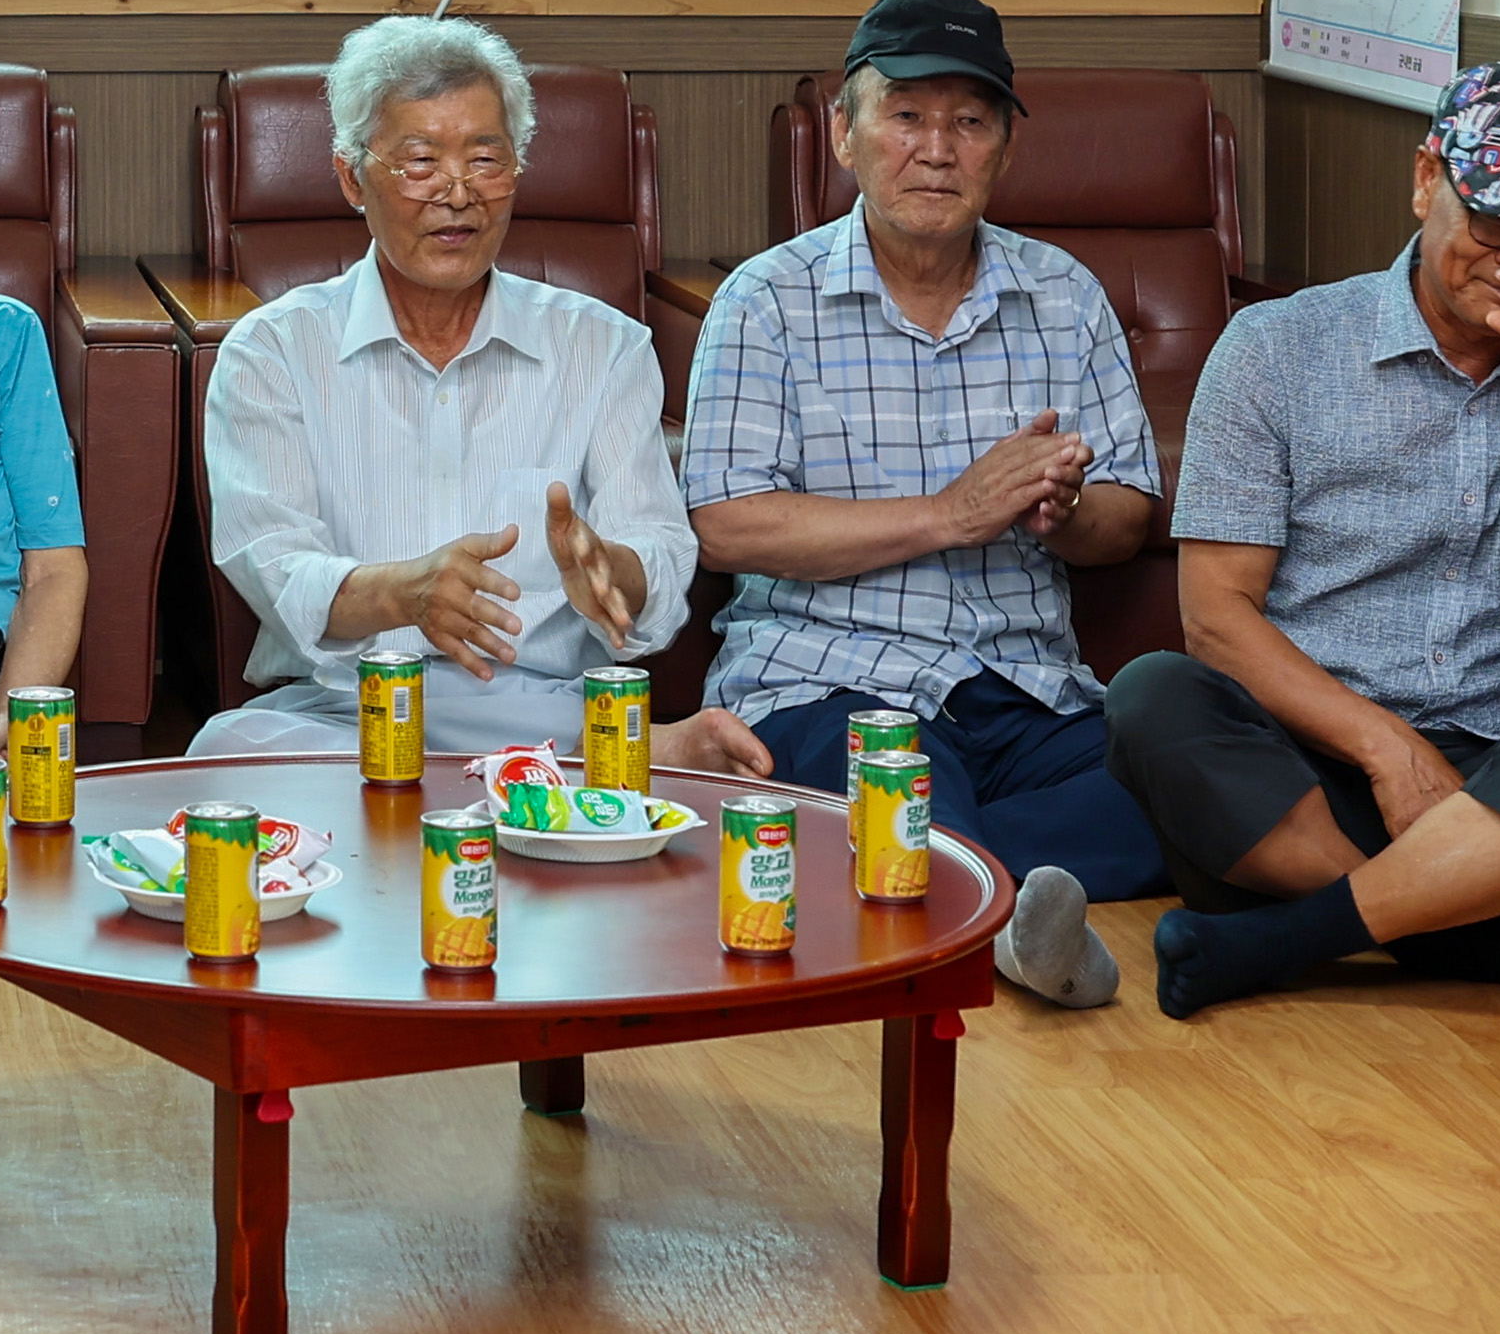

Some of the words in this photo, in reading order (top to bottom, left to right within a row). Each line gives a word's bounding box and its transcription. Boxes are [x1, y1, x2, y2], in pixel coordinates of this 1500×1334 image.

[751, 850, 791, 874] 망고
[453, 864, 493, 890] 망고
[751, 873, 791, 890] Mango
[453, 888, 494, 905] Mango
